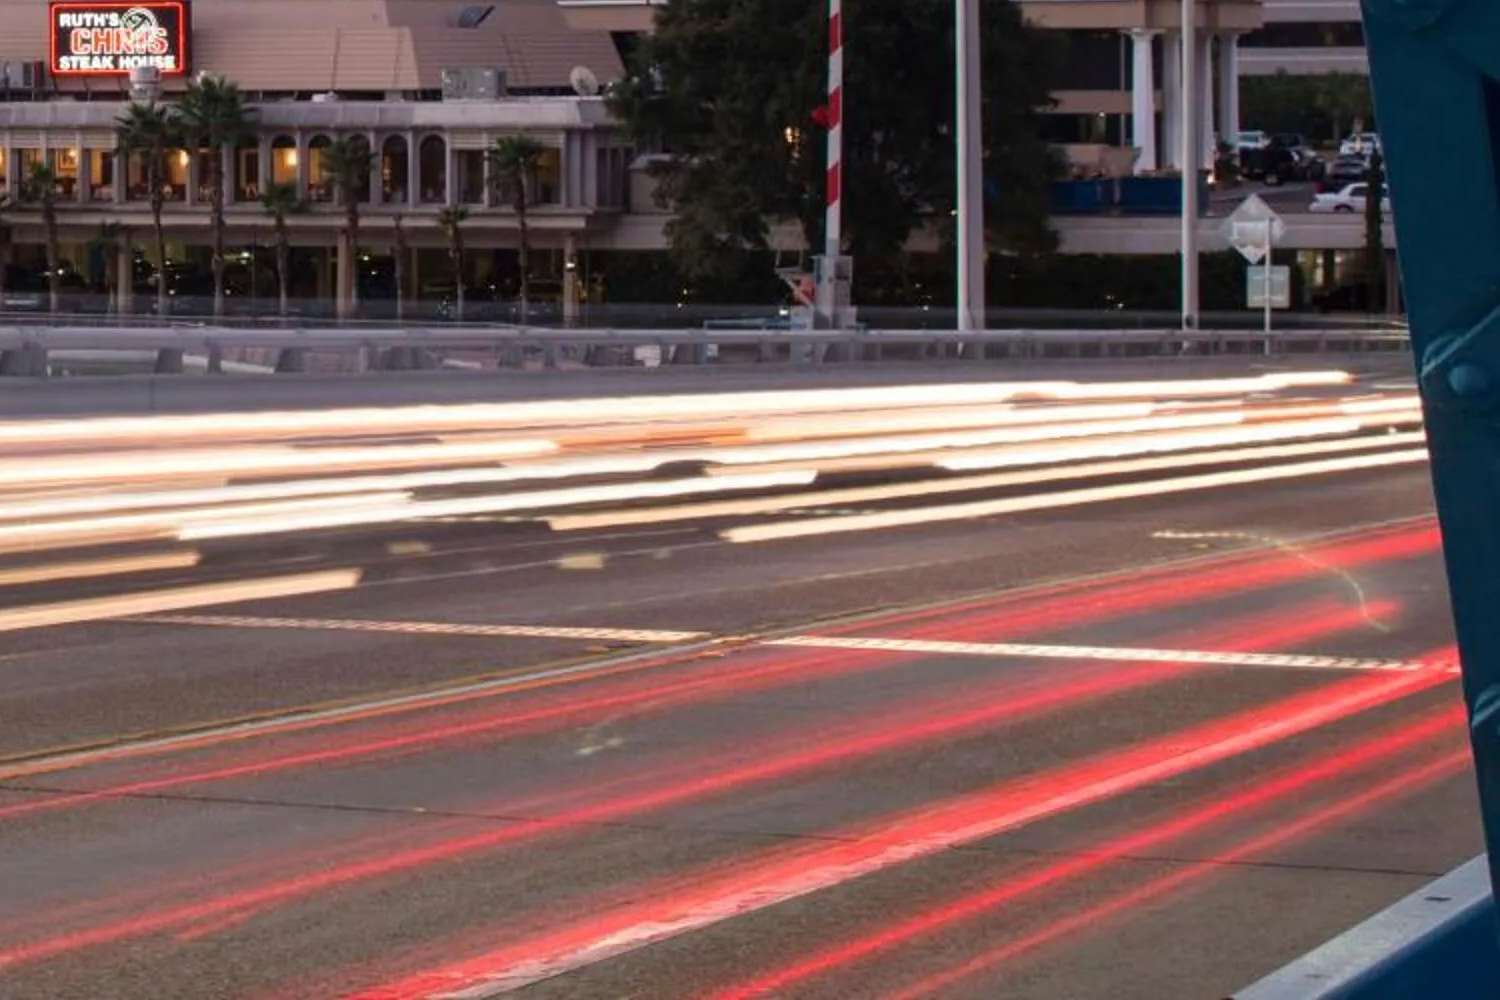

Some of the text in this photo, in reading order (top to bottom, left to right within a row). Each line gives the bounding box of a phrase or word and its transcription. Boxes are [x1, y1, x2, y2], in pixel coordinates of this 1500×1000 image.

[59, 12, 119, 27] RUTH'S
[70, 27, 169, 55] CHRIS
[59, 55, 175, 69] STEAK HOUSE
